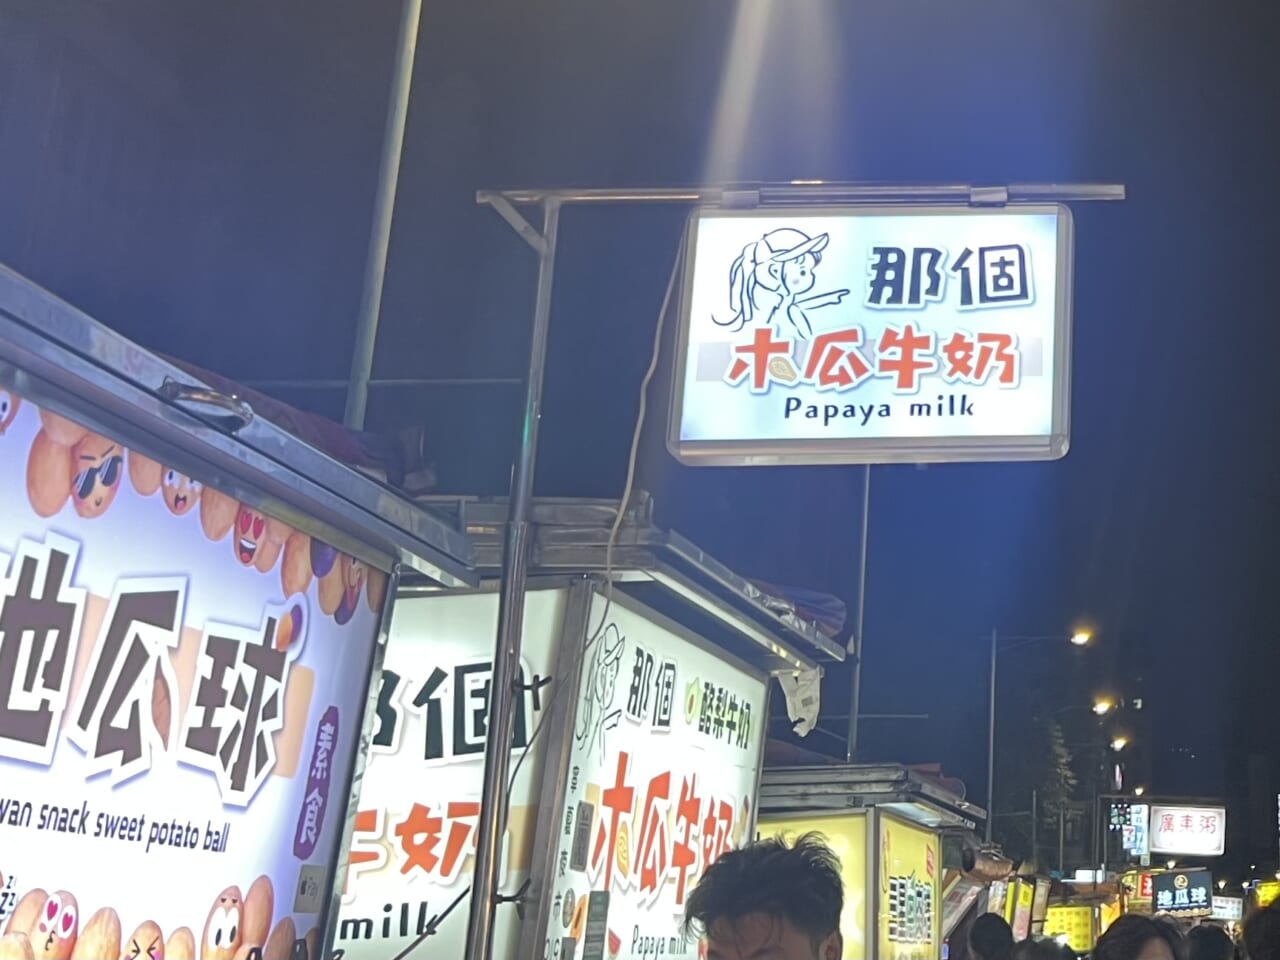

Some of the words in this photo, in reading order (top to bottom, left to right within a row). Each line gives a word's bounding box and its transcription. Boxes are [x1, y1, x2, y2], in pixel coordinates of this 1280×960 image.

[867, 243, 1029, 306] 那個
[728, 324, 1015, 390] 木瓜牛奶
[784, 396, 891, 426] Papaya
[909, 394, 975, 417] milk
[626, 646, 676, 727] 那個
[698, 681, 751, 750] 酪梨牛奶
[300, 722, 336, 844] 素食
[37, 800, 90, 834] snack
[94, 812, 145, 842] sweet
[145, 818, 199, 853] potato
[203, 820, 231, 852] ball
[1158, 813, 1217, 834] 廣東粥
[339, 901, 438, 940] milk
[1156, 886, 1207, 906] 地瓜球
[631, 924, 666, 960] Papaya
[668, 935, 687, 955] milk
